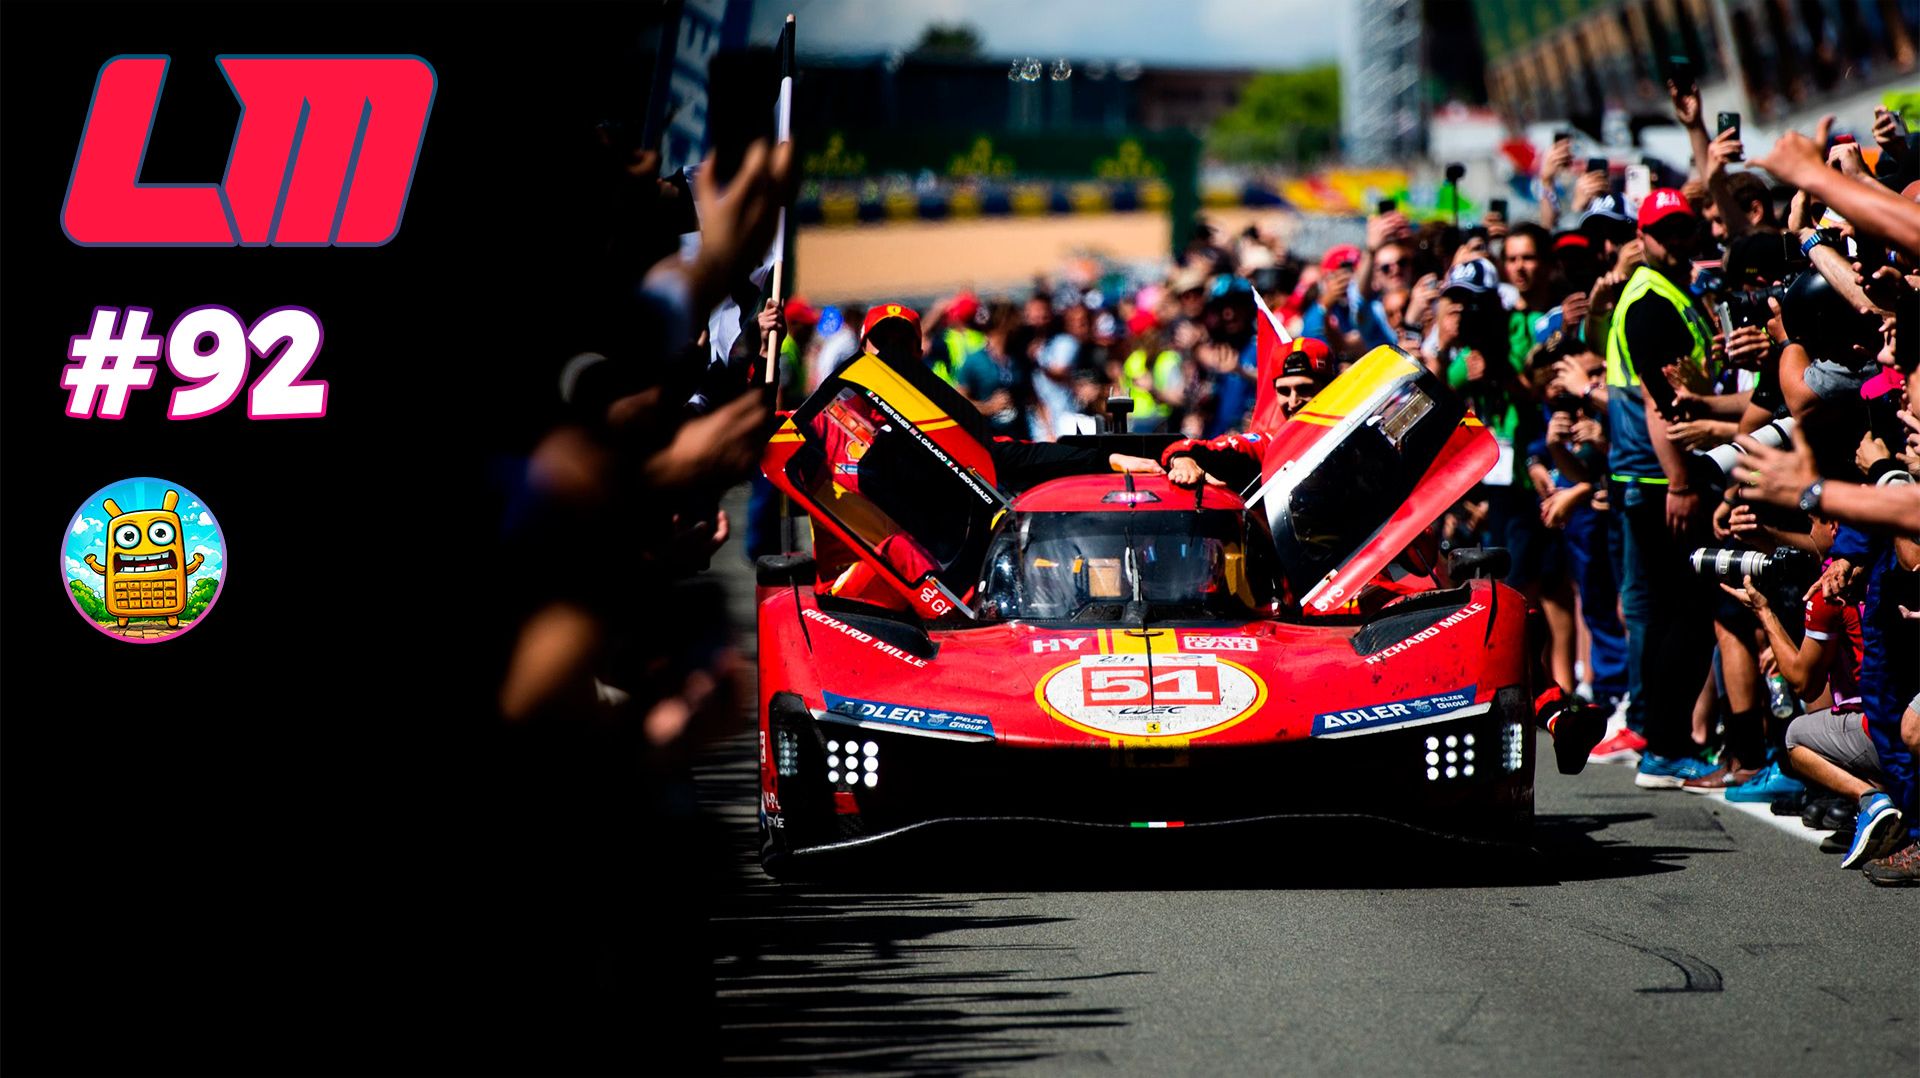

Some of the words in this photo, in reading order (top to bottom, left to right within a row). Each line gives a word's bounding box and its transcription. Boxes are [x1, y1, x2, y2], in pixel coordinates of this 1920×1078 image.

[879, 401, 895, 415] PIER
[893, 413, 911, 430] GUIDI
[921, 438, 948, 462] CALADO
[1438, 602, 1486, 629] MILLE
[801, 608, 873, 643] RICHARD
[873, 640, 928, 668] MILLE
[1032, 637, 1088, 653] HY
[1189, 641, 1253, 650] CAR
[1090, 669, 1213, 701] 51
[1431, 694, 1464, 704] PELZER
[1436, 700, 1470, 710] GROUP
[834, 701, 926, 723] ADLER
[1118, 705, 1187, 715] WEC
[1323, 703, 1412, 729] ADLER
[949, 721, 984, 731] GROUP
[953, 715, 988, 725] PELZER
